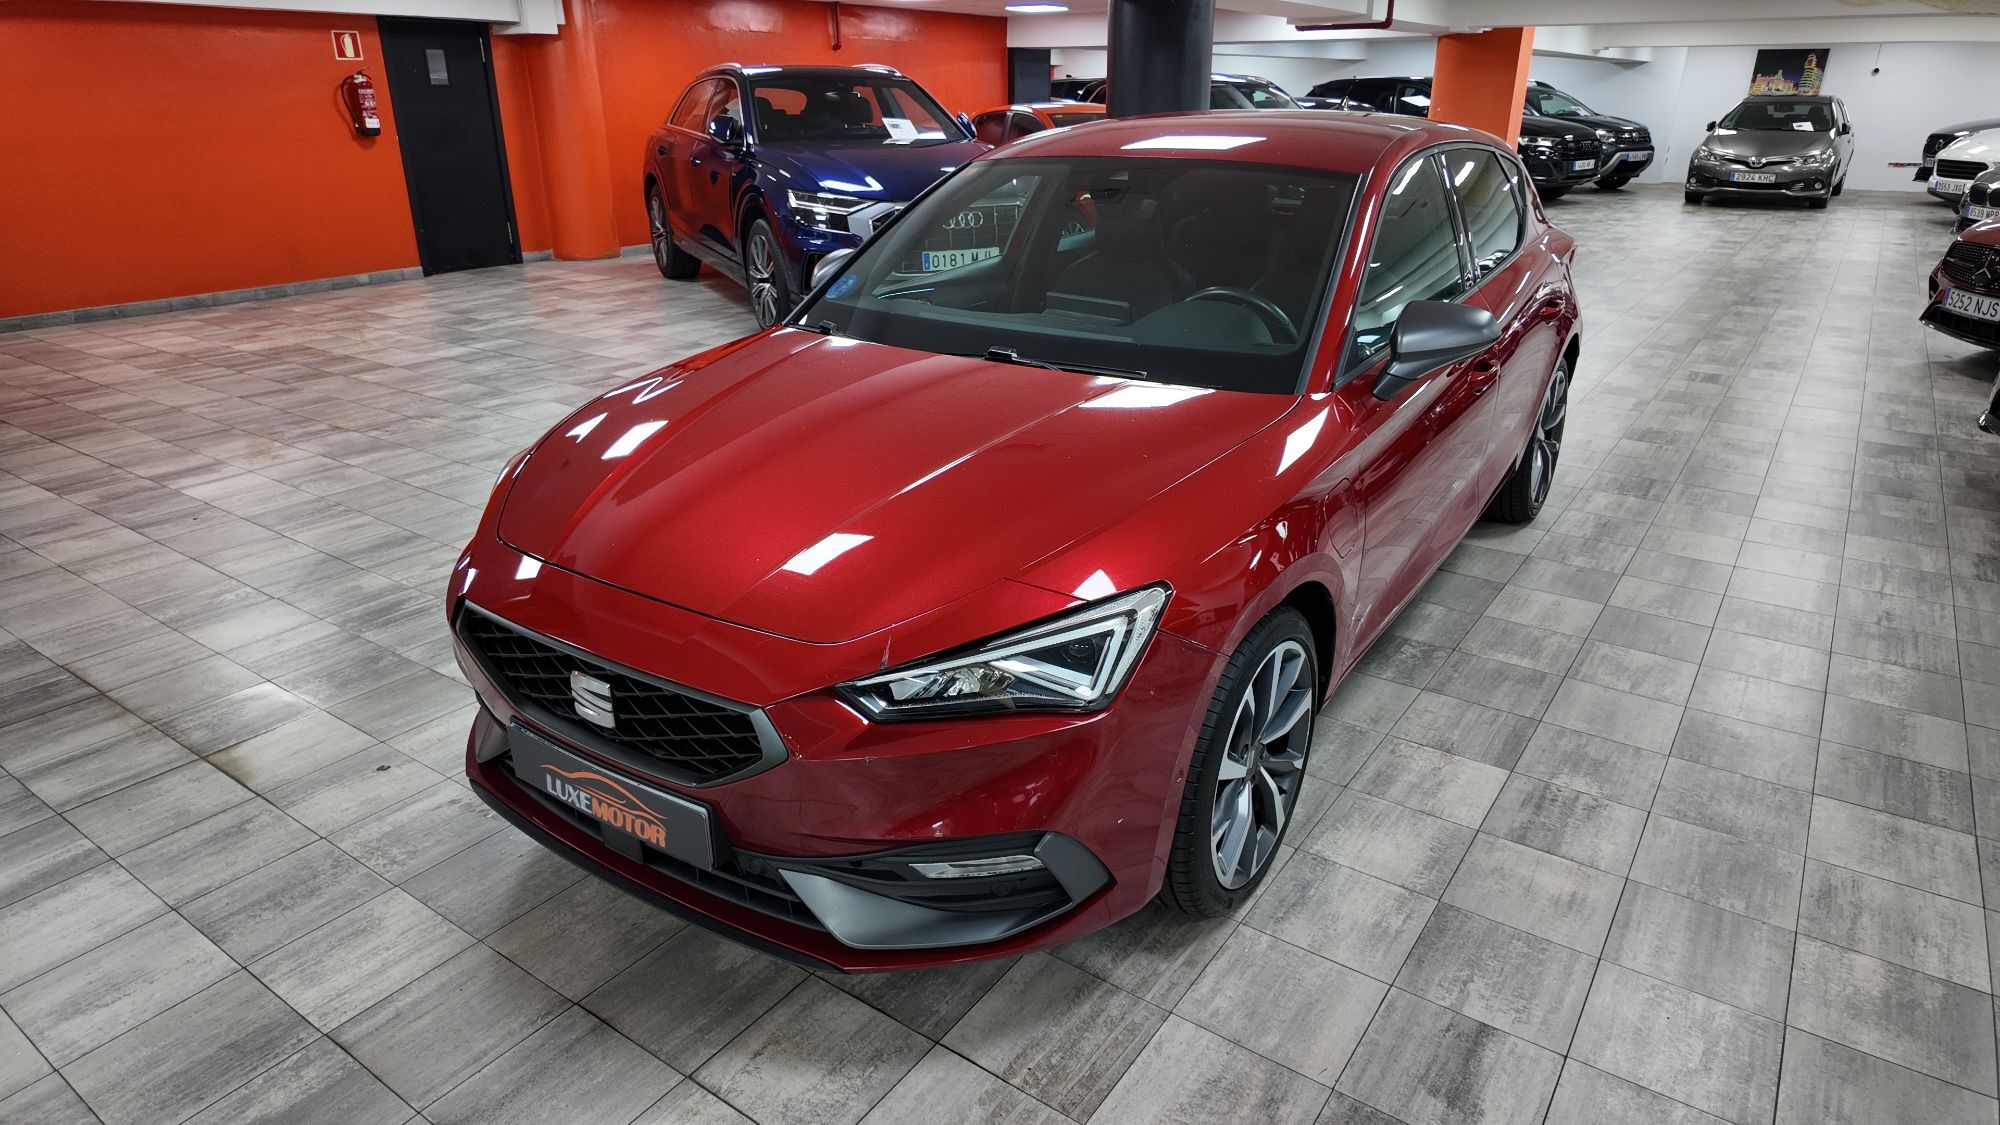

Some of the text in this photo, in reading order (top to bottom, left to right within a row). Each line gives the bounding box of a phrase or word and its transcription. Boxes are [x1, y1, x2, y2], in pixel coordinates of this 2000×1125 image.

[1736, 173, 1755, 181] 2924
[1970, 206, 1985, 219] 8539
[932, 253, 965, 269] 0181
[1948, 291, 2000, 318] 5252 NJS
[545, 773, 667, 848] LUXEMOTOR
